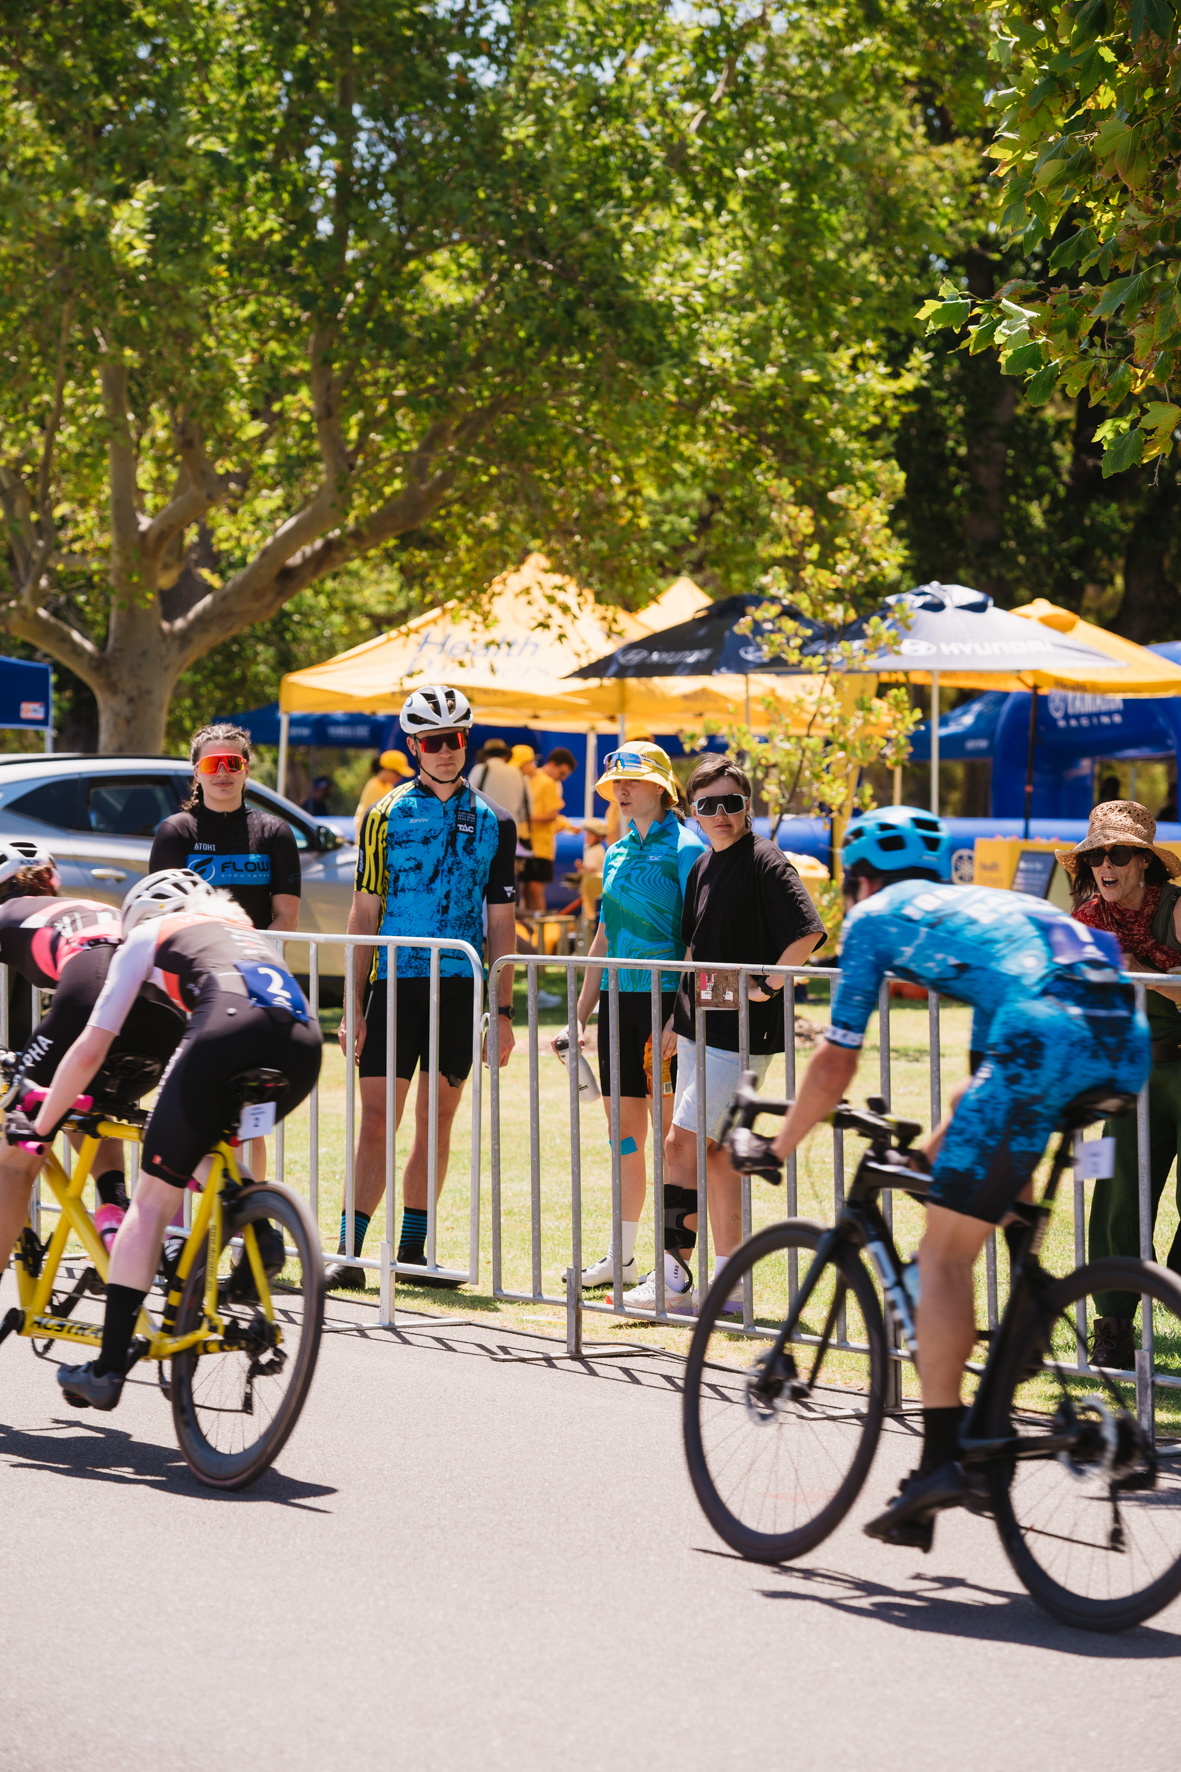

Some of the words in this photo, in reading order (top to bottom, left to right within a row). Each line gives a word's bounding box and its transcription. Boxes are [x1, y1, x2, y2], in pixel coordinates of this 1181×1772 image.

[942, 640, 1054, 656] HYUNDAI
[1056, 713, 1123, 728] RACING
[457, 824, 475, 833] TAC
[221, 861, 269, 873] FLOW
[257, 966, 292, 999] 2
